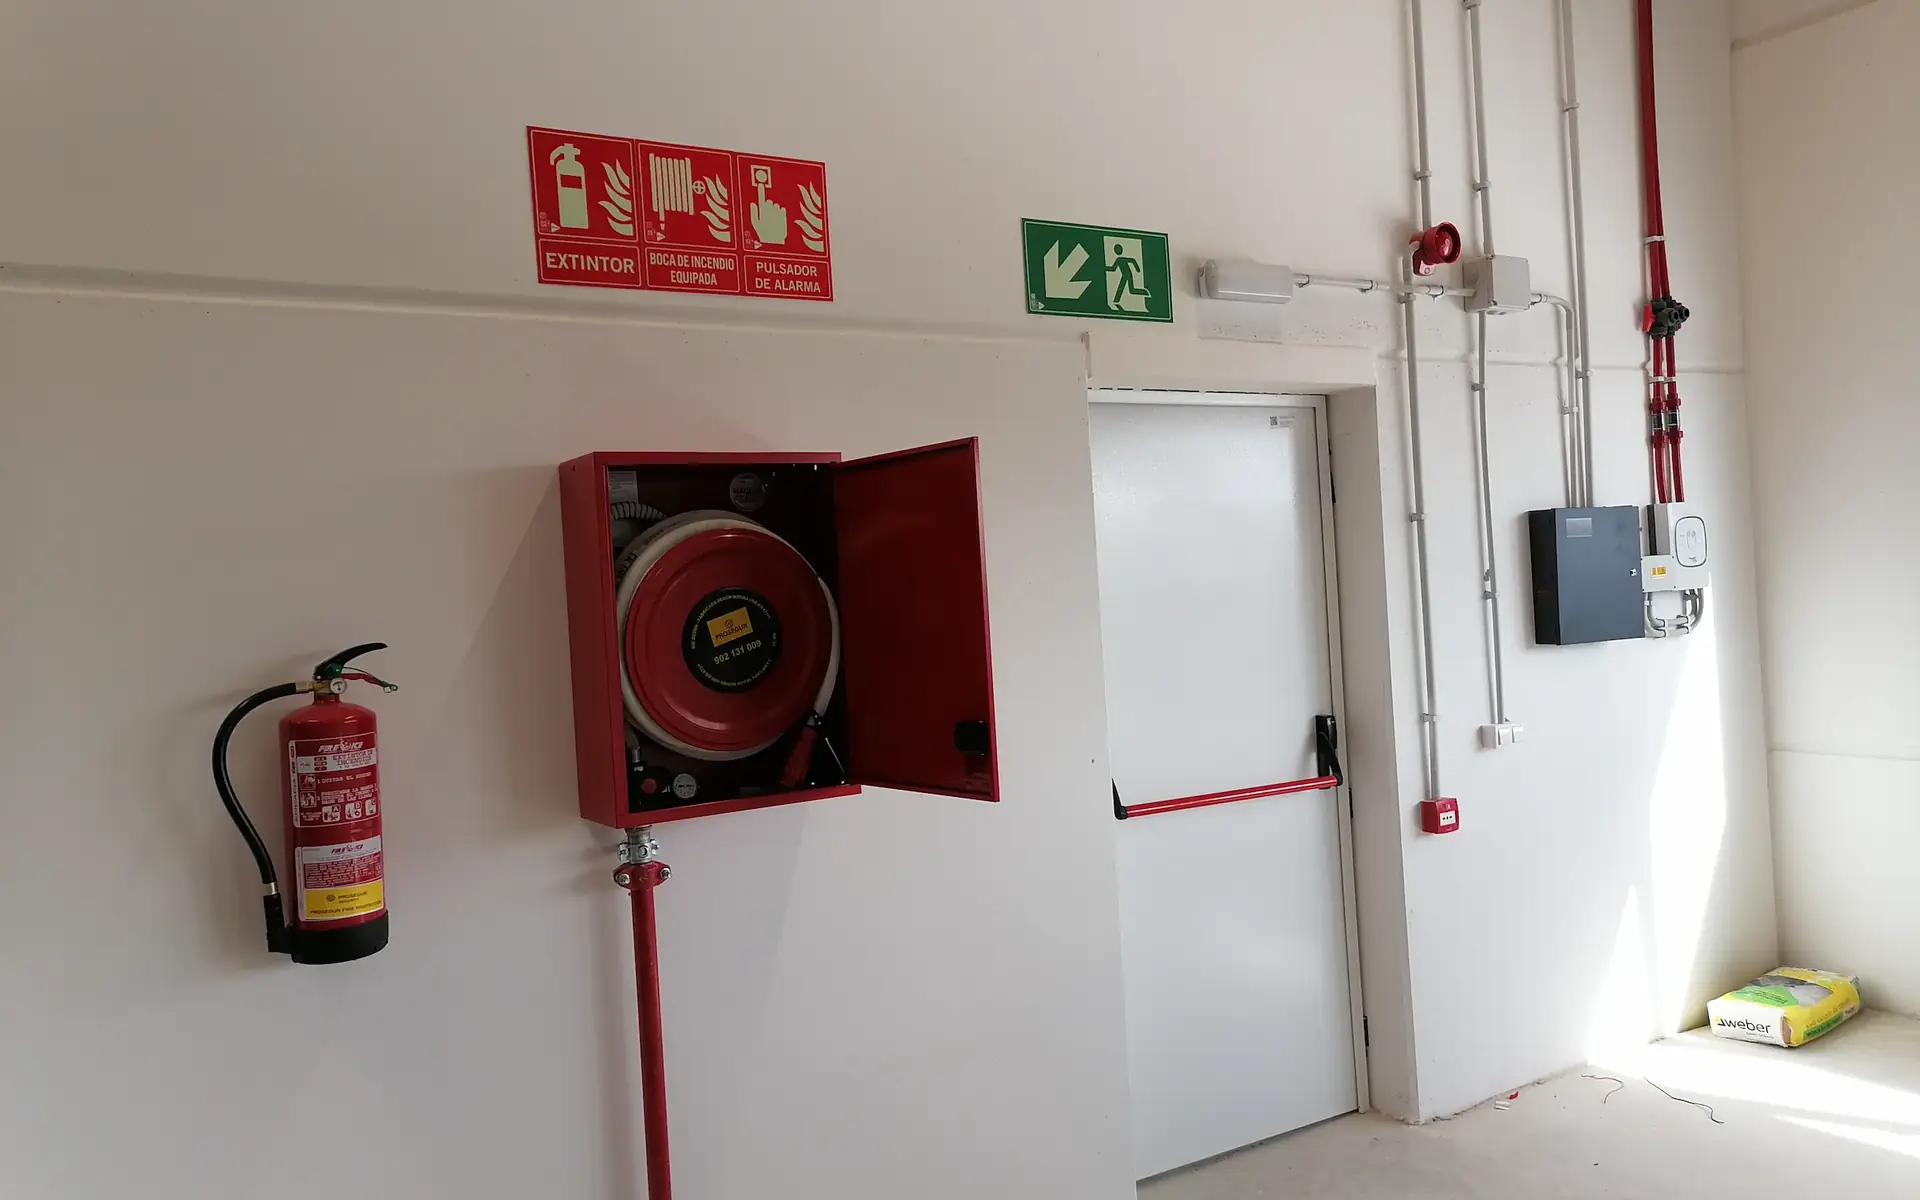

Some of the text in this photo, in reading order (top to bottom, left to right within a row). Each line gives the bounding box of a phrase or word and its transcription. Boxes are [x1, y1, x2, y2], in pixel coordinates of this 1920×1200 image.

[546, 252, 635, 274] EXTINTOR
[650, 253, 735, 271] BOCA DE INCENDIO
[756, 262, 818, 277] PULSADOR
[670, 270, 718, 286] EQUIPADA
[755, 278, 821, 293] DE ALARMA
[714, 623, 749, 640] PROSEGUR
[714, 652, 730, 665] 902
[731, 645, 746, 658] 131
[746, 639, 762, 652] 009
[1723, 1018, 1771, 1034] weber
